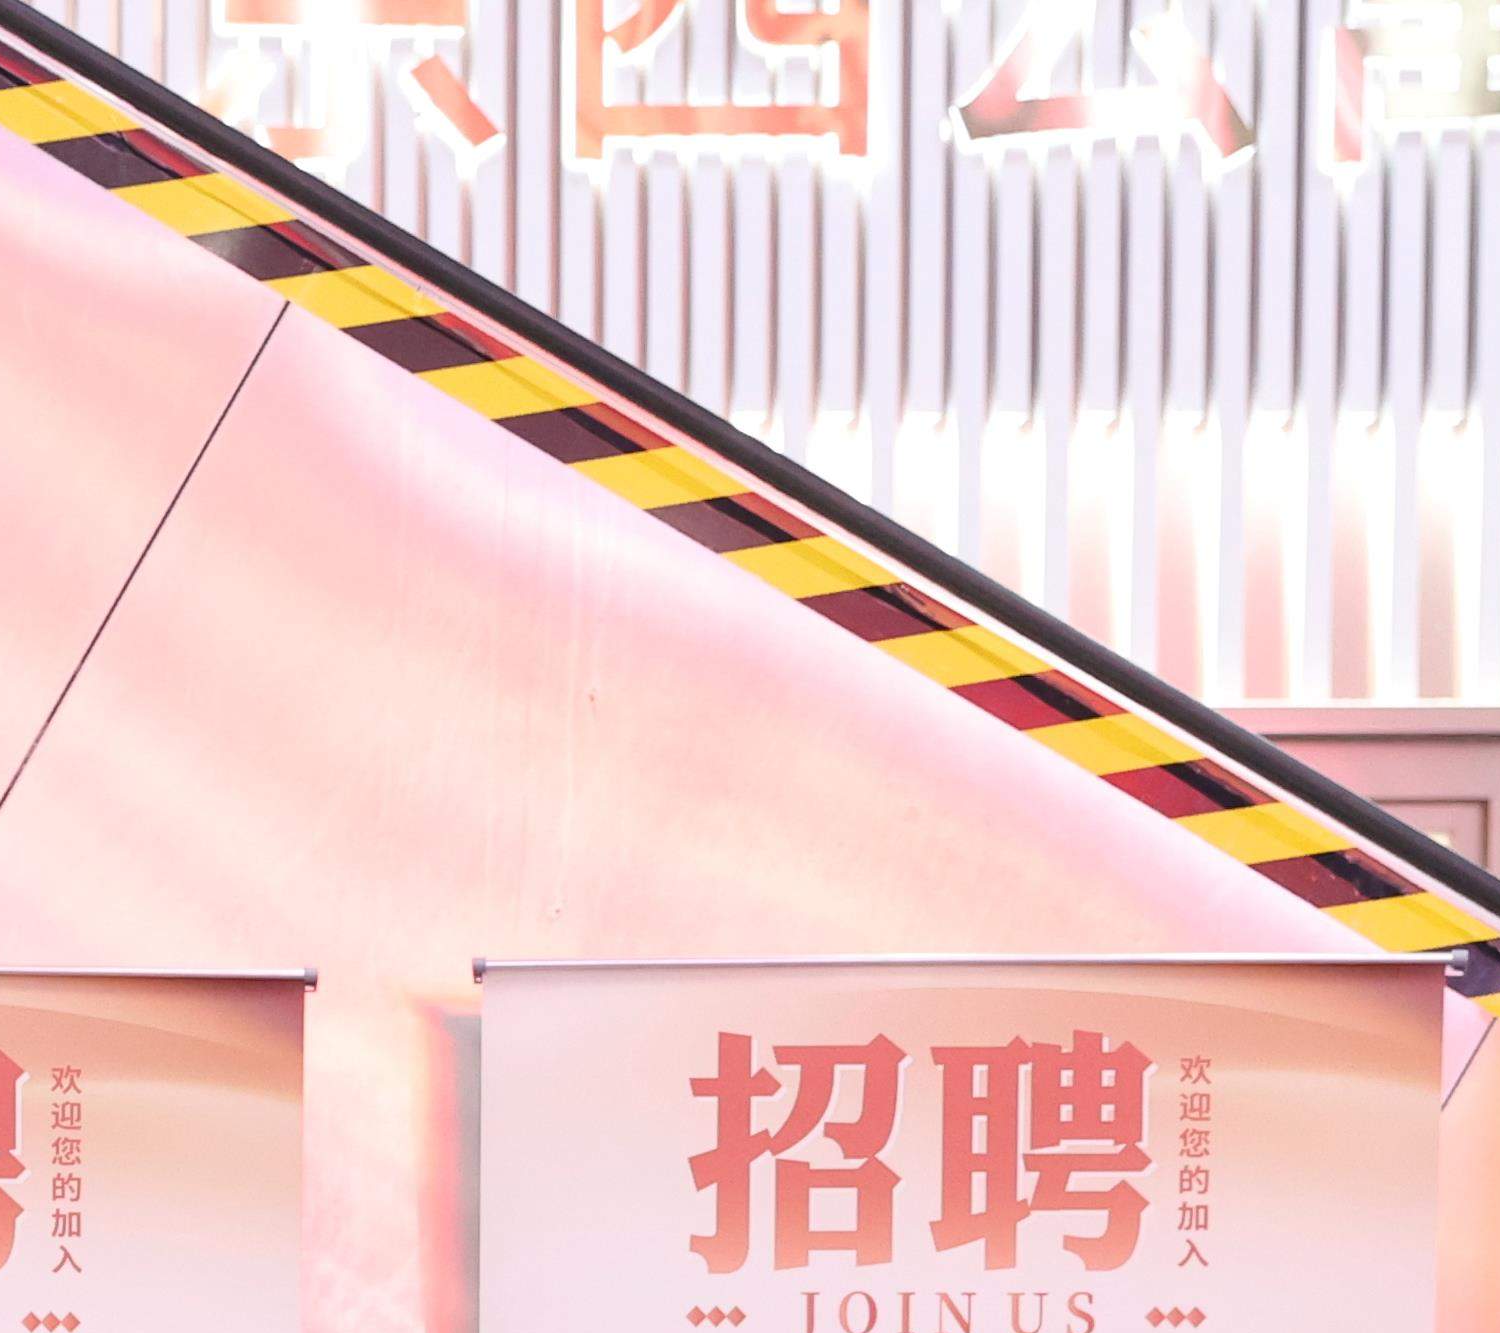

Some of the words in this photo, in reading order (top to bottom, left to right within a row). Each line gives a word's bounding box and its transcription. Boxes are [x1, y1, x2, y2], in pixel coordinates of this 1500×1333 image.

[50, 1064, 83, 1275] 欢迎您的加入
[687, 1029, 1150, 1274] 招聘
[1178, 1054, 1212, 1268] 欢迎您的加入
